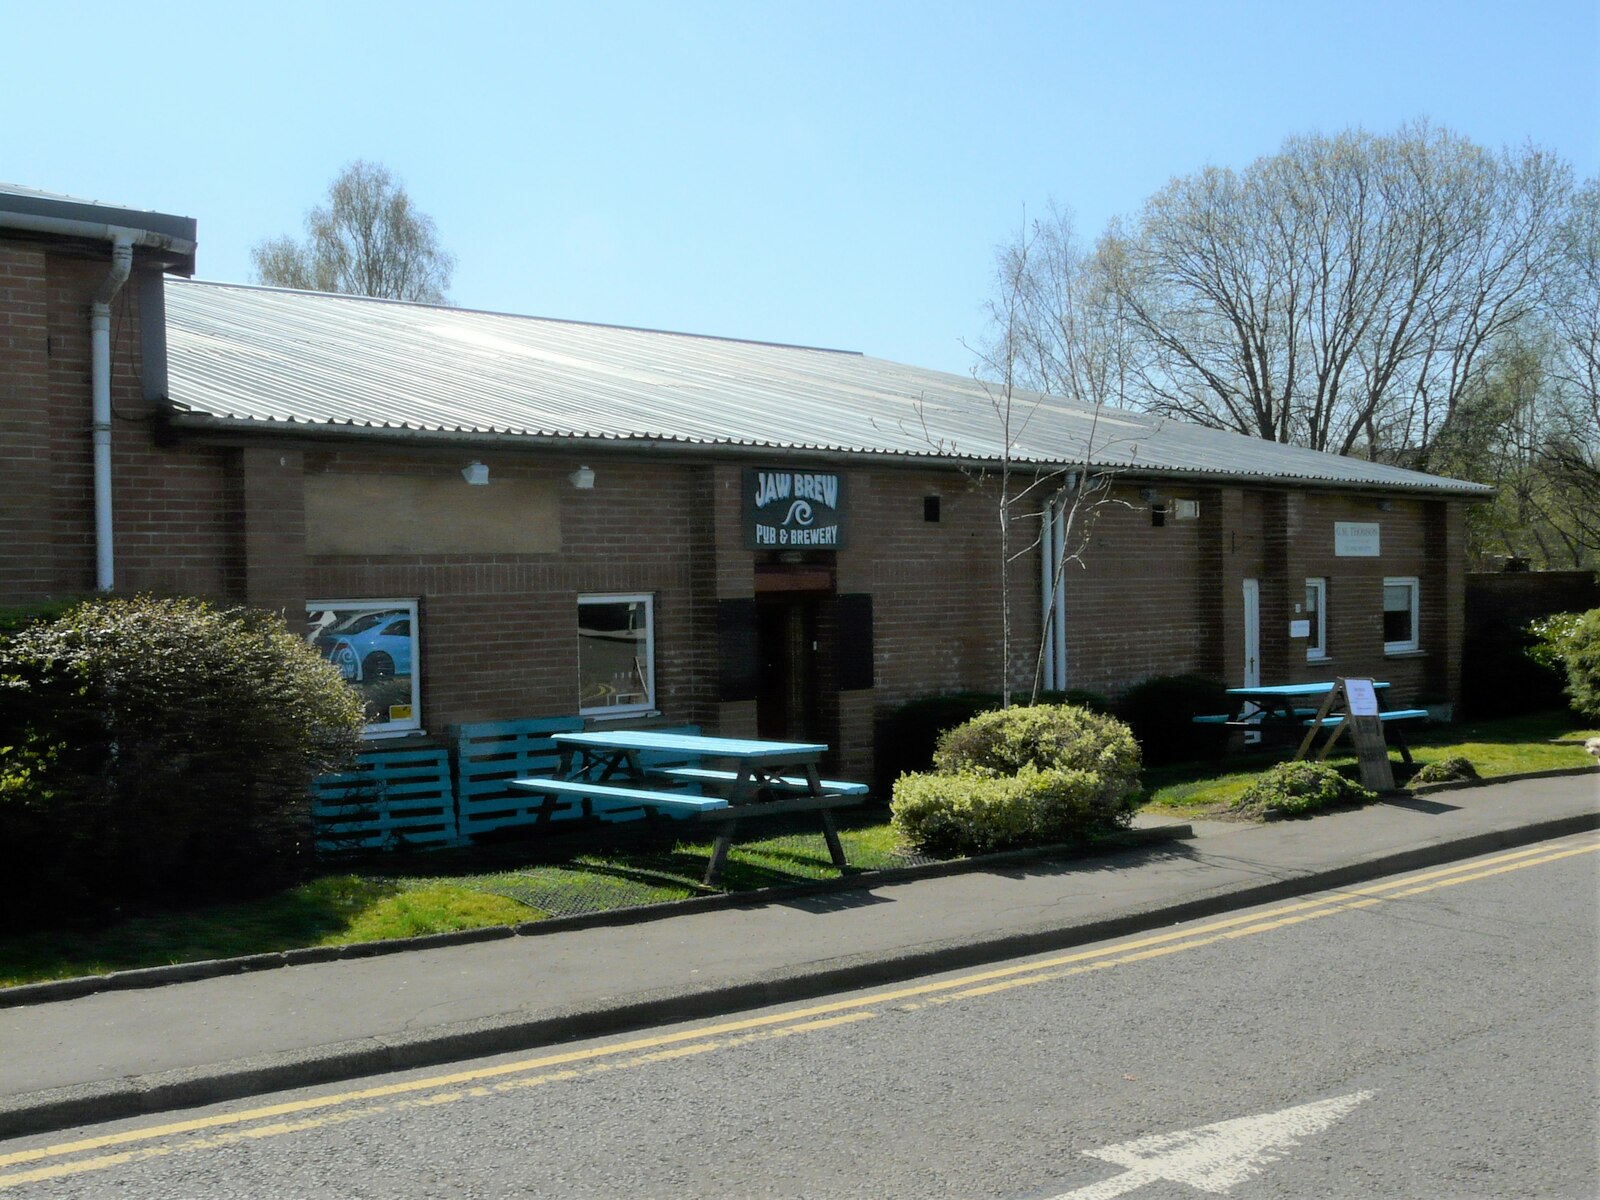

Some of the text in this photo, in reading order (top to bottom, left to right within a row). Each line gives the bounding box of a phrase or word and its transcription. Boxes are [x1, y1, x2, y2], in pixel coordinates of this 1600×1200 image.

[755, 472, 838, 510] JAW BREW
[756, 523, 838, 544] PUB & BREWERY
